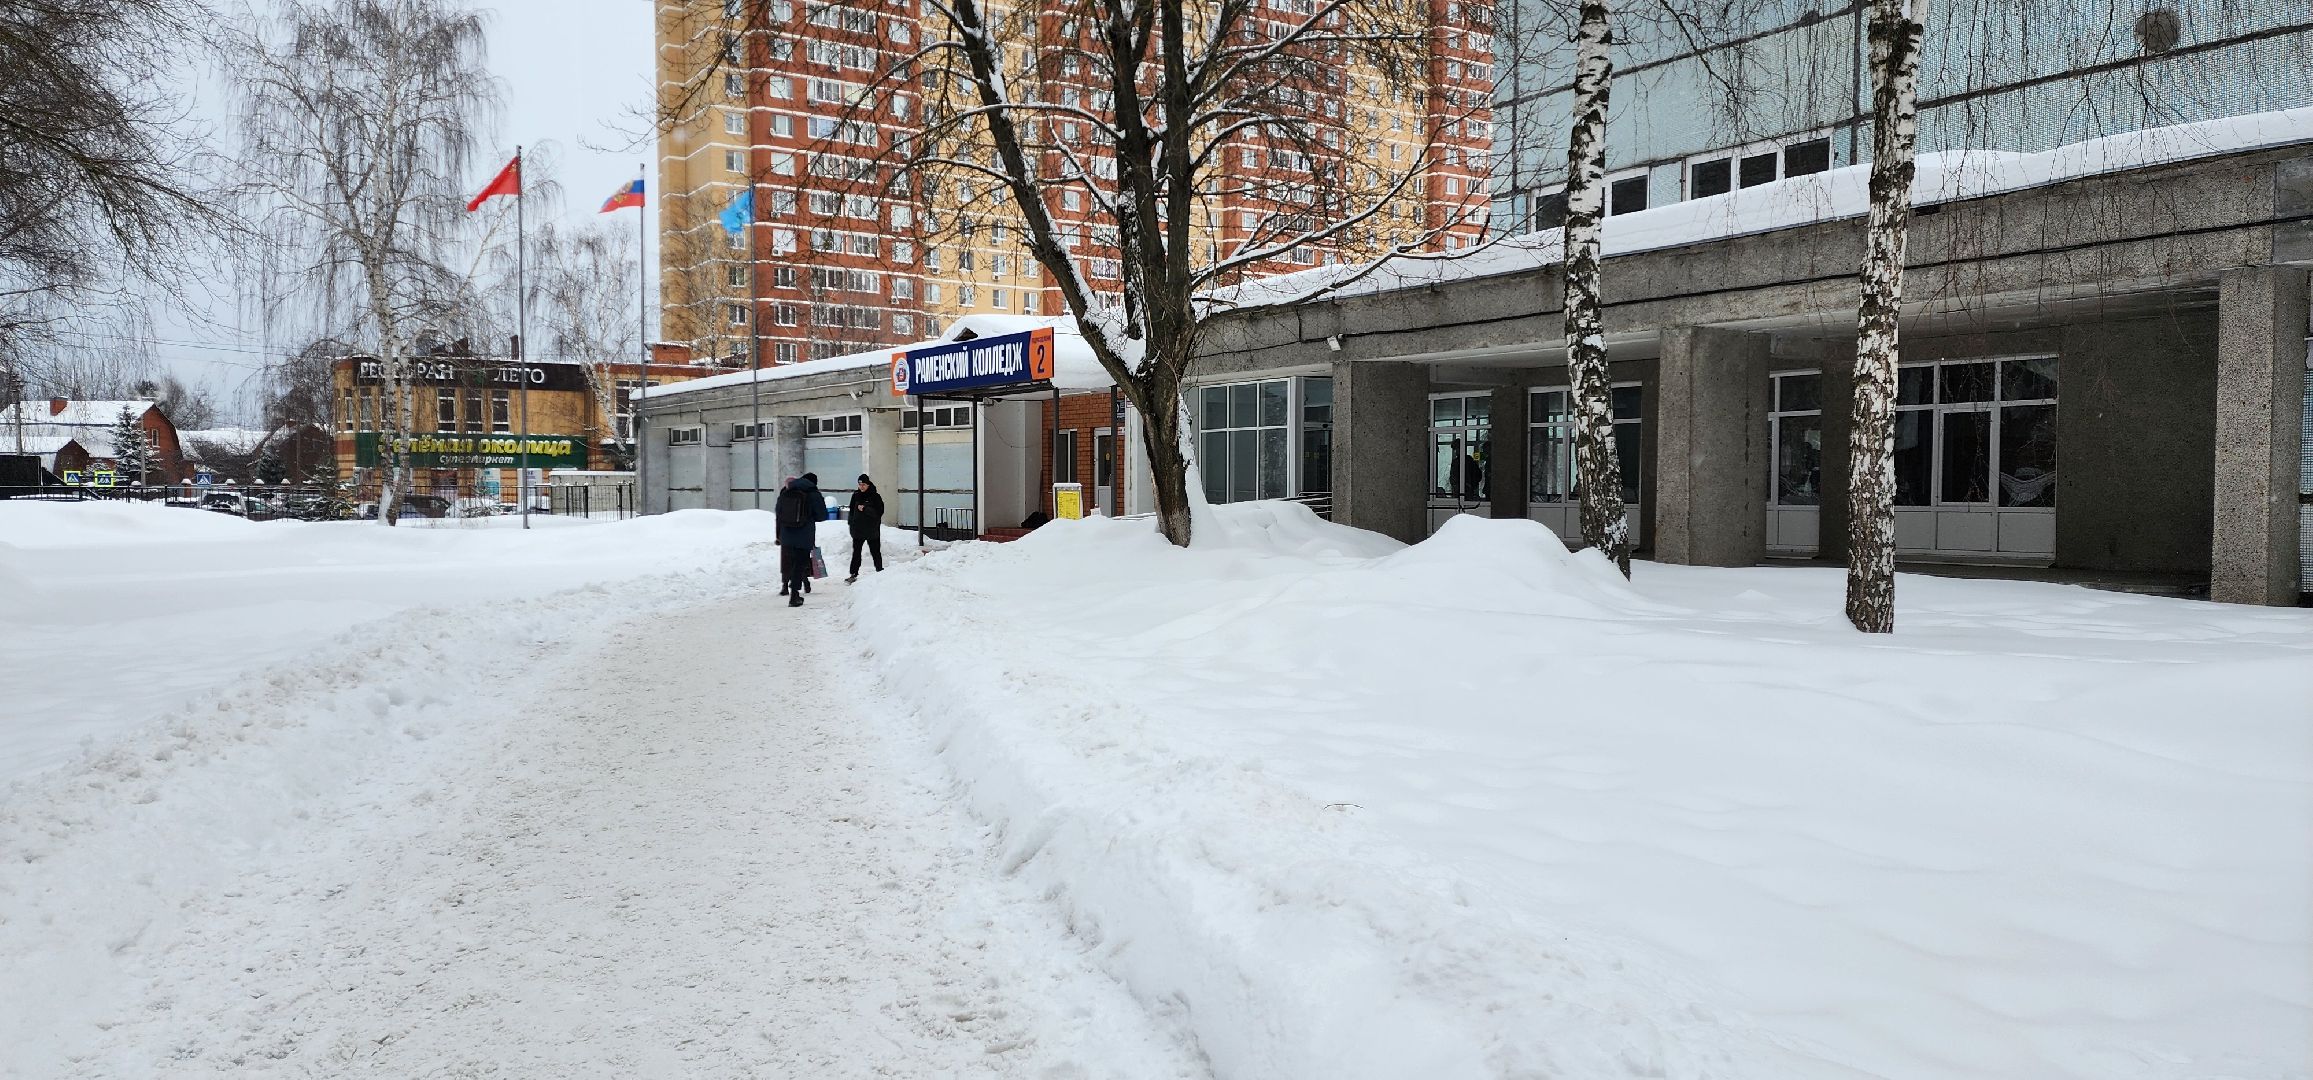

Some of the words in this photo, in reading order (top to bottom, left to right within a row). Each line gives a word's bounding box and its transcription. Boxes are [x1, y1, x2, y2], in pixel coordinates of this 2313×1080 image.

[360, 362, 456, 379] РЕСРАН
[494, 367, 544, 384] ЛЕТО
[914, 345, 969, 384] РАМЕНСКИЙ
[972, 341, 1023, 377] КОЛЛЕДЖ
[1037, 344, 1045, 374] 2
